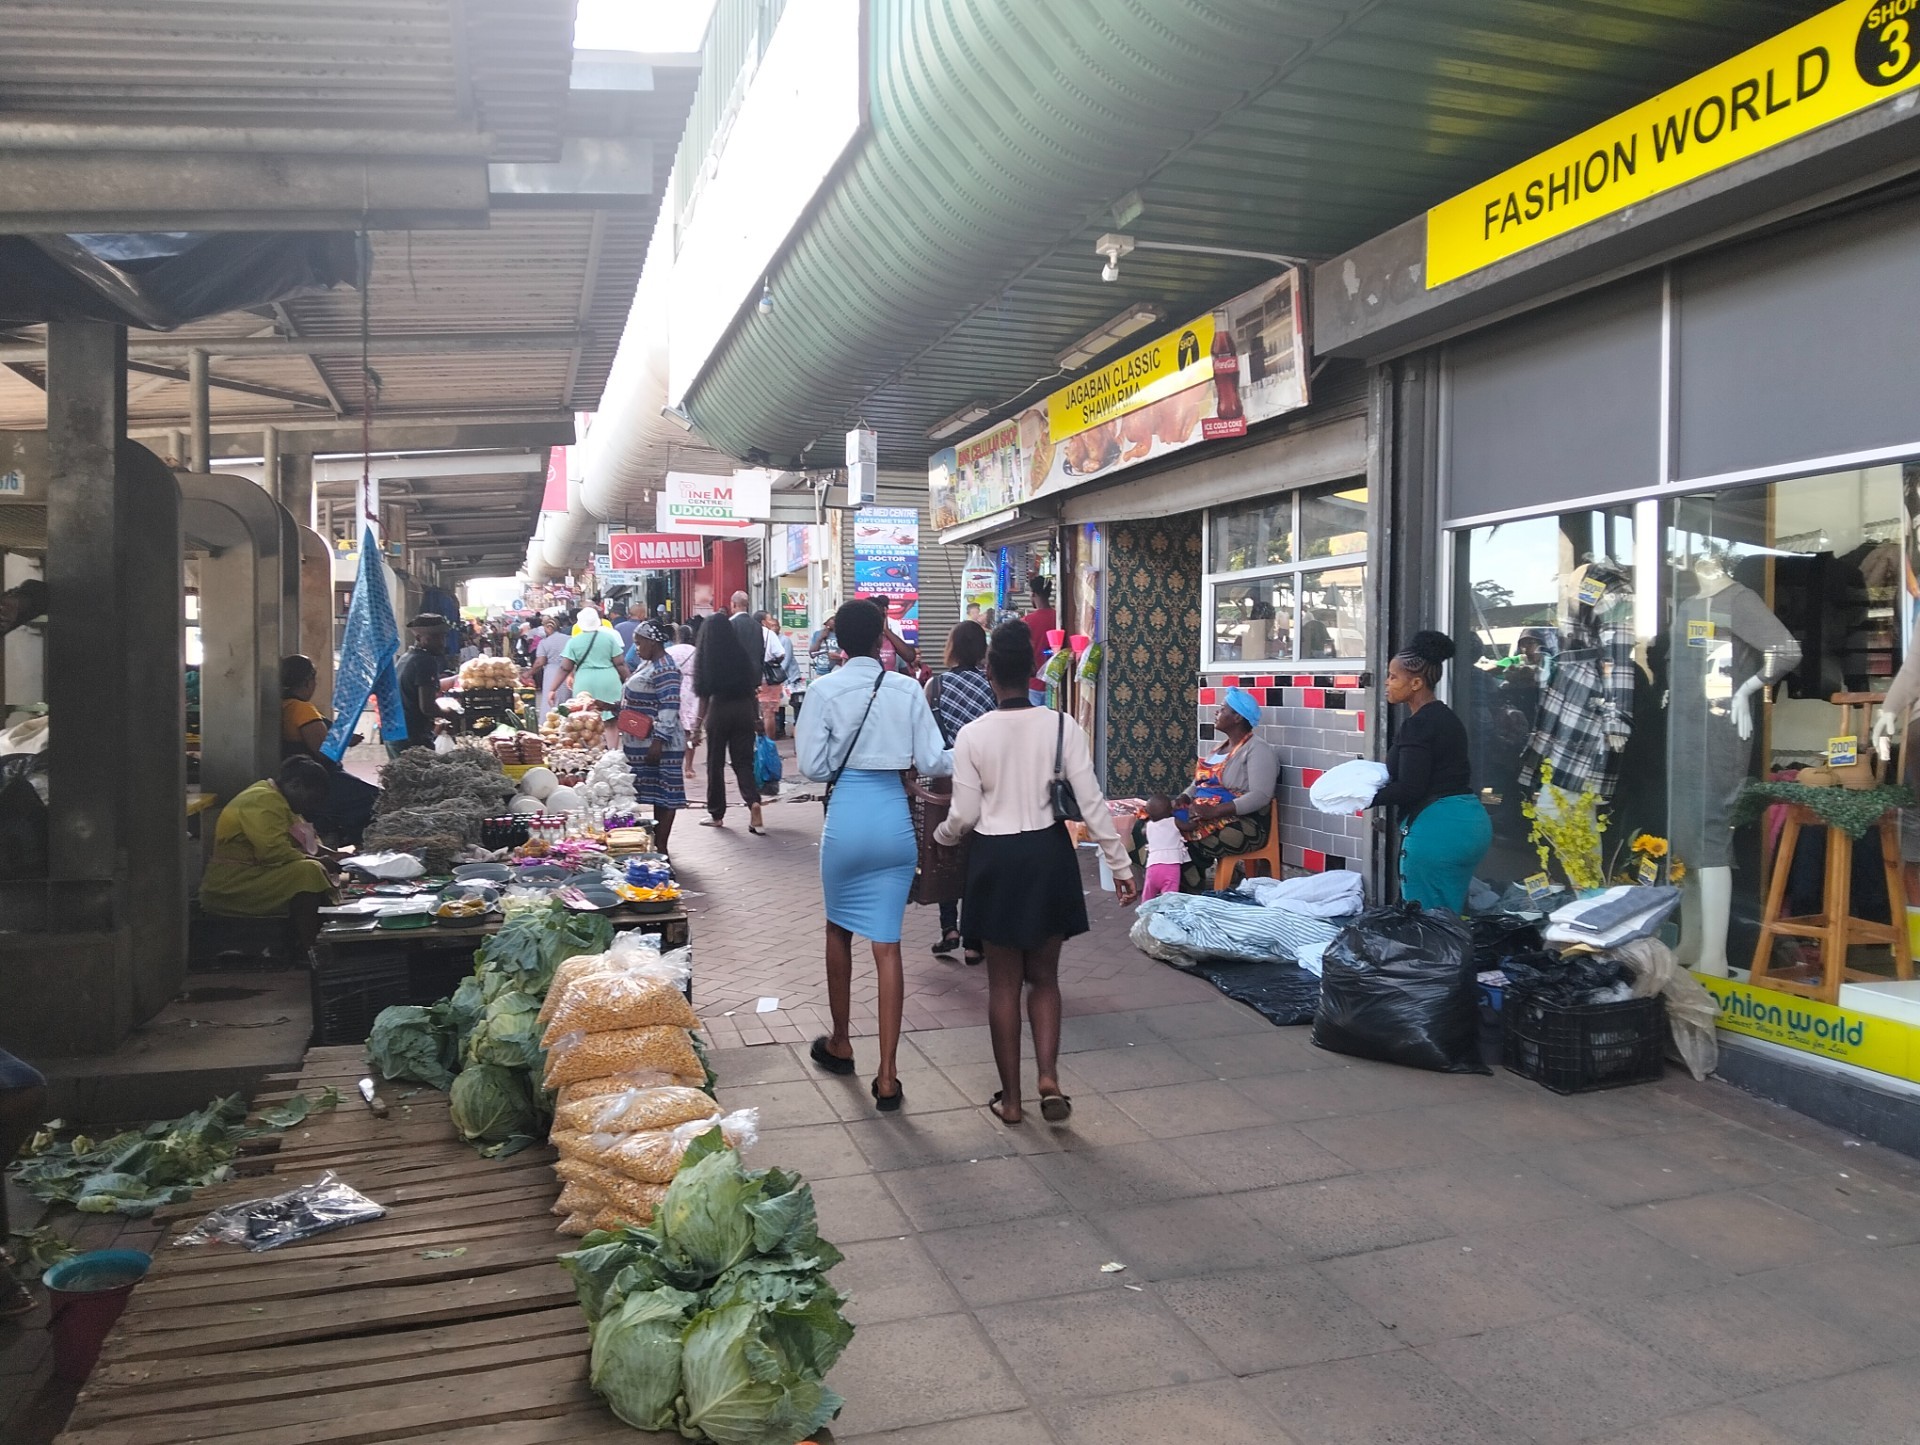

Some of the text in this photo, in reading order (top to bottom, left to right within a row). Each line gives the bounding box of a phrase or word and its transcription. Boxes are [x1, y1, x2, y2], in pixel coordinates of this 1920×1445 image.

[1877, 18, 1911, 78] 3
[1483, 45, 1830, 242] FASHION WORLD
[1179, 334, 1196, 351] SHOP
[1065, 347, 1162, 410] JAGABAN CLASSIC
[1082, 381, 1142, 424] SHAWARMA
[1213, 422, 1228, 430] COLD
[1228, 420, 1243, 428] COKE
[639, 541, 701, 559] NAHU
[966, 581, 992, 589] Rocket
[1787, 1009, 1864, 1047] world
